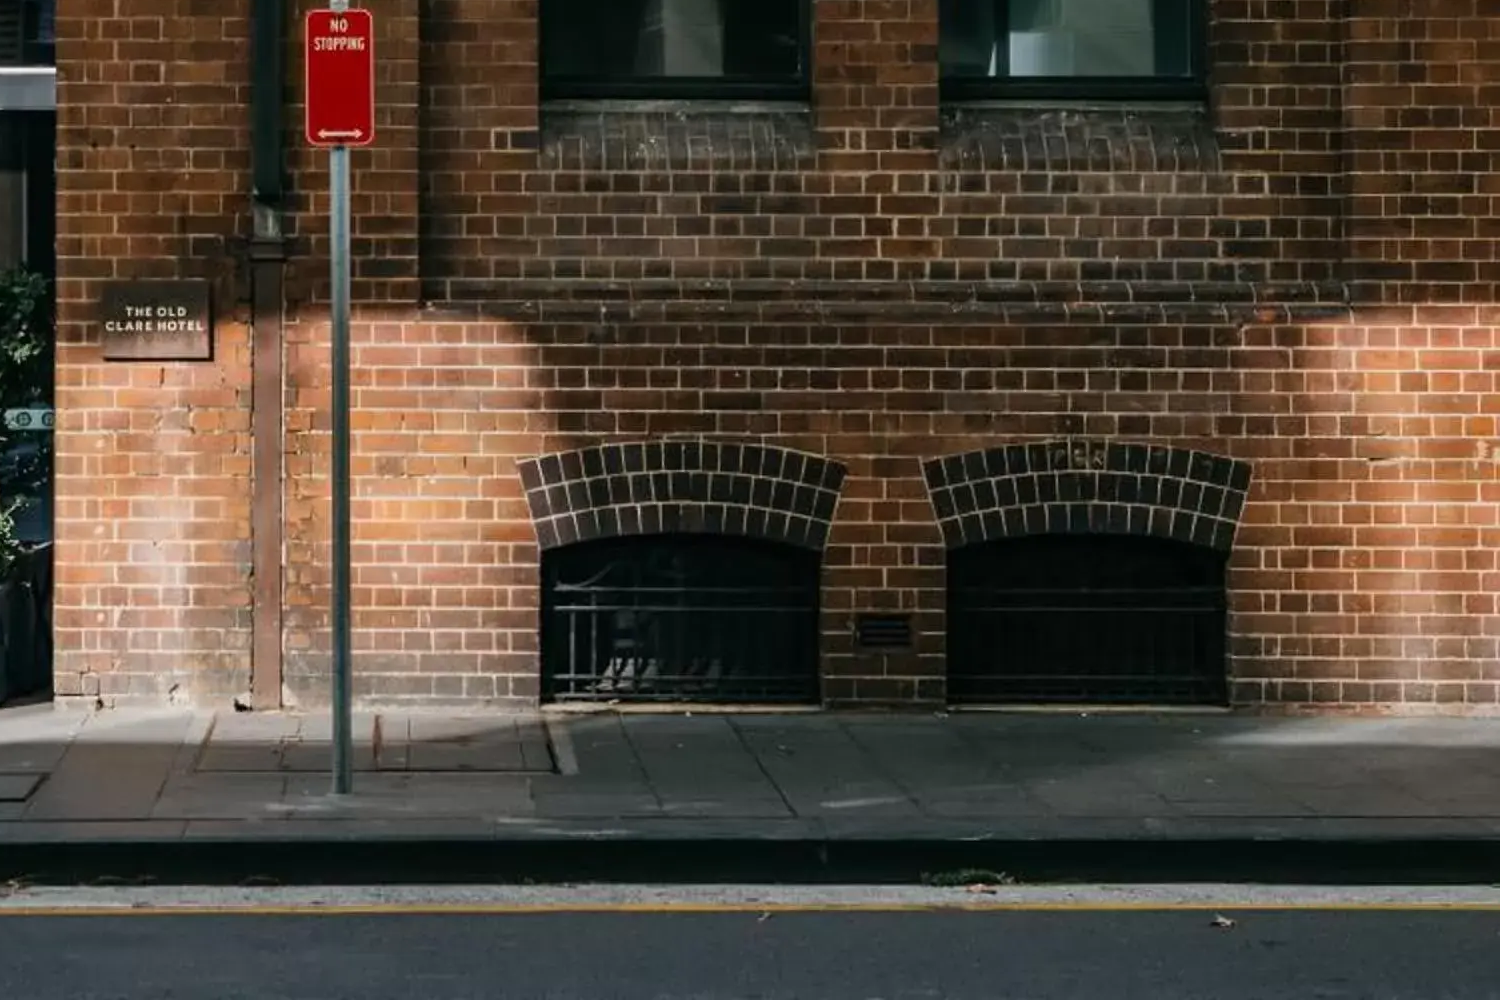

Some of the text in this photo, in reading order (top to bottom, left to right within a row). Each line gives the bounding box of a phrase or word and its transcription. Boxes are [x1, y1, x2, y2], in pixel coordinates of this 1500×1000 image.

[330, 18, 348, 33] NO
[314, 37, 365, 51] STOPPING
[125, 306, 187, 317] THE OLD
[105, 320, 204, 332] CLARE HOTEL
